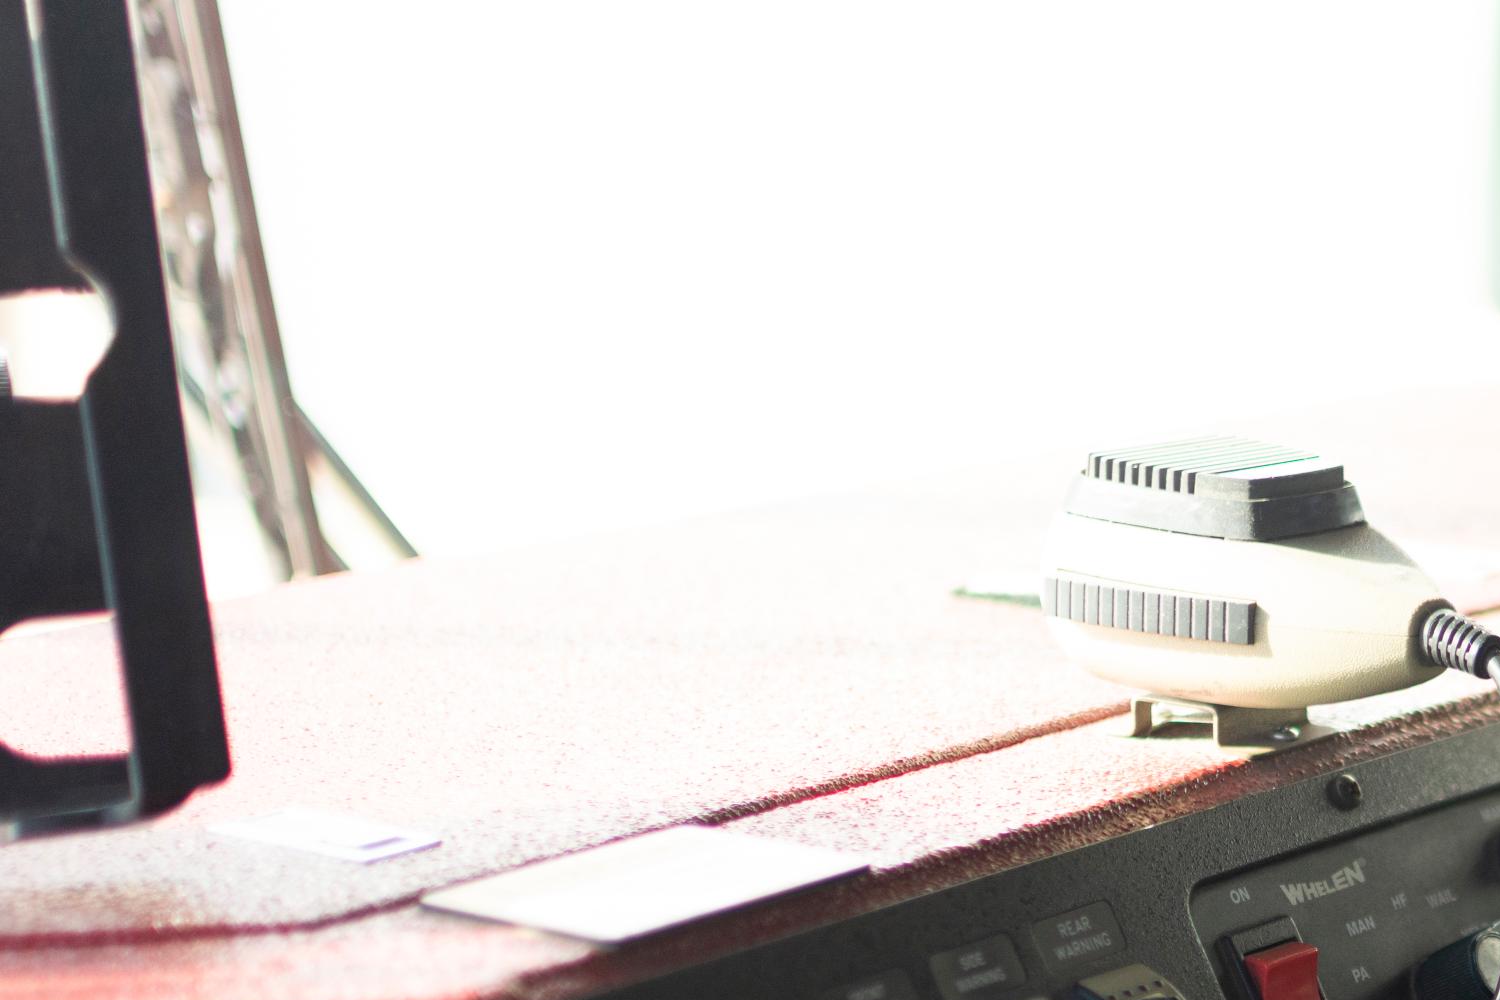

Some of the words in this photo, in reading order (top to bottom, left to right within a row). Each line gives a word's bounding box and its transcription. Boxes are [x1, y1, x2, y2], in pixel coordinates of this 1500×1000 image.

[1279, 859, 1366, 906] WHELEN
[1229, 886, 1251, 906] ON
[1390, 892, 1407, 911] HF
[1425, 888, 1458, 910] WAIL
[1056, 915, 1092, 939] REAR
[1345, 915, 1376, 938] MAN
[1054, 931, 1112, 961] WARNING
[1351, 966, 1371, 984] PA
